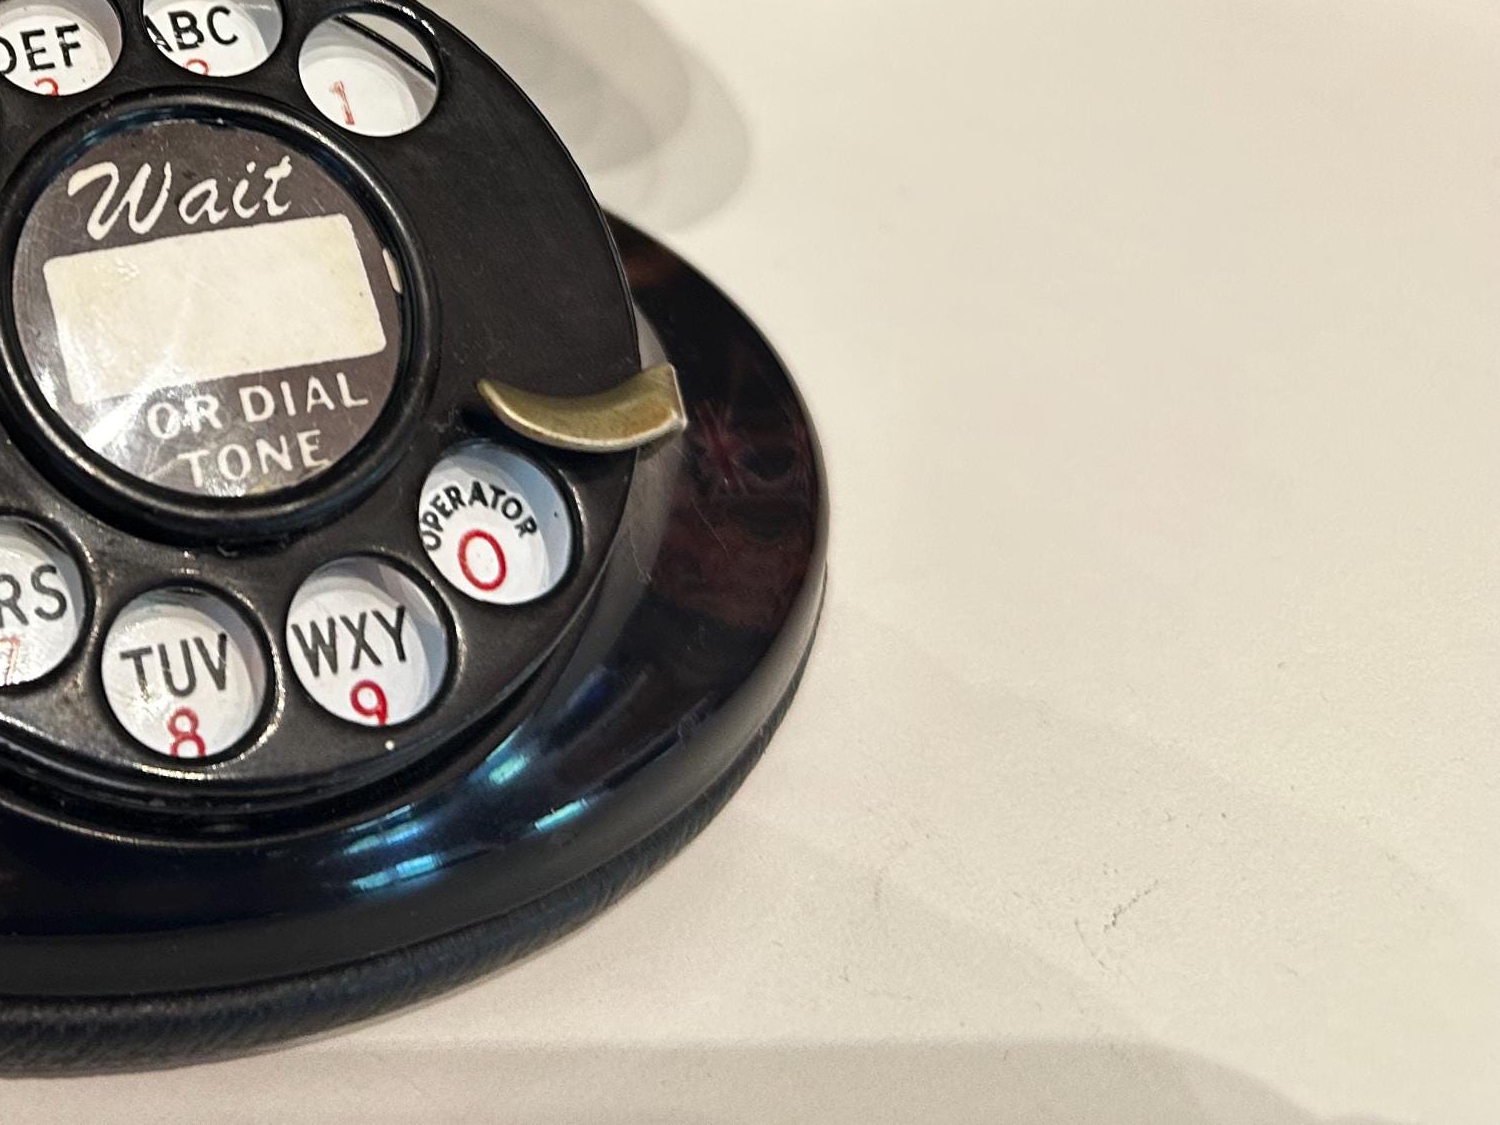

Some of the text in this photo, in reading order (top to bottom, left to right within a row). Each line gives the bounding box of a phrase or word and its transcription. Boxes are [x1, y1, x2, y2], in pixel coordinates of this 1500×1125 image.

[67, 156, 293, 240] Wait
[146, 372, 368, 440] OR DIAL
[177, 430, 332, 487] TONE
[420, 481, 537, 551] OPERATOR
[119, 633, 228, 697] TUV
[291, 605, 407, 677] WXY
[167, 707, 206, 757] 8
[349, 678, 389, 726] 9
